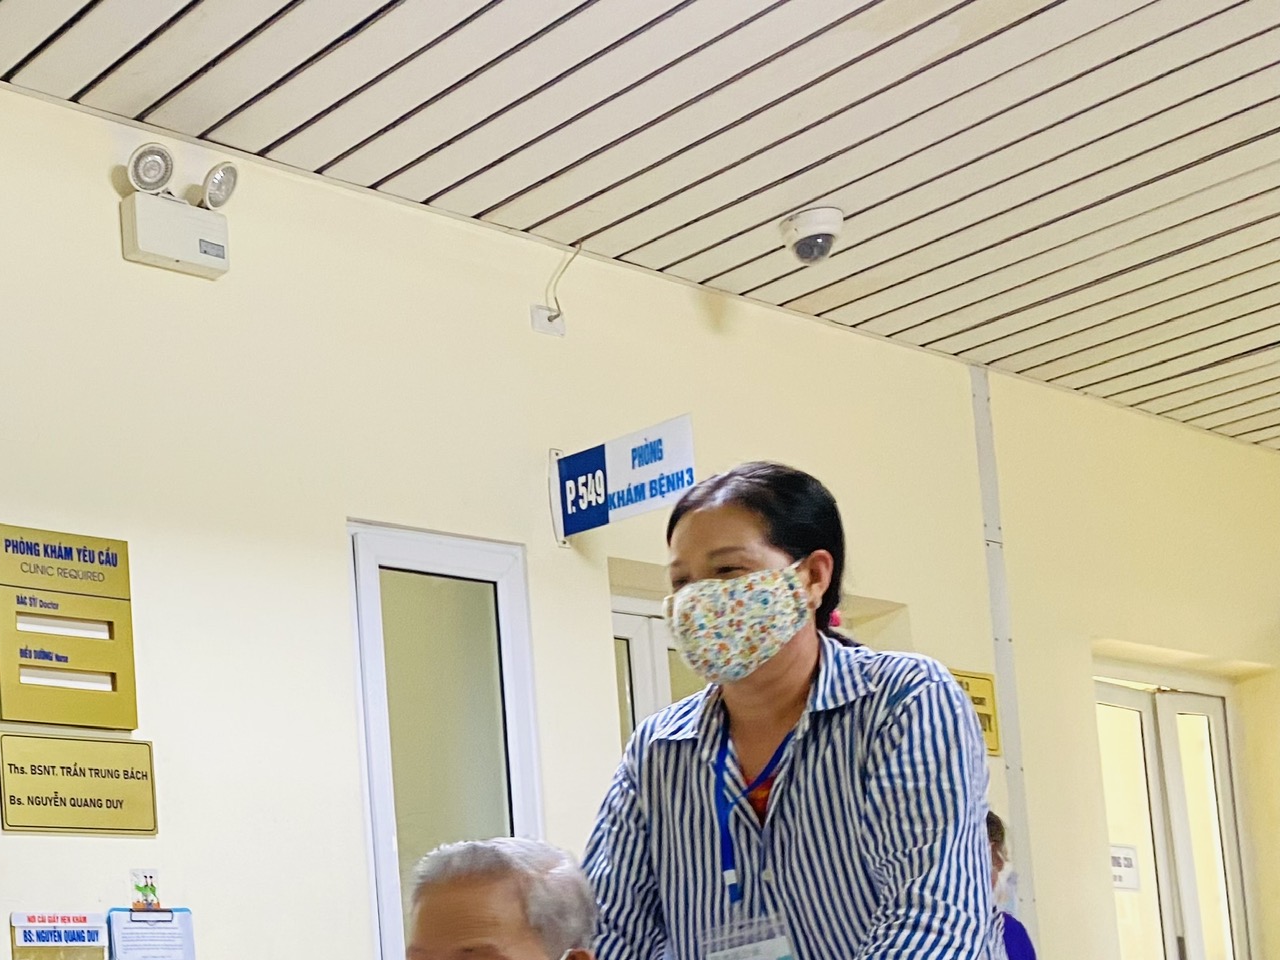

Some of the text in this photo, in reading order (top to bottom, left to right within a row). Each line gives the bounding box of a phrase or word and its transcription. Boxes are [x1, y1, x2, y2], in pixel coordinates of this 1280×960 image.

[631, 437, 664, 470] PHÒNG
[608, 467, 695, 511] KHÁM BỆNH 3
[4, 537, 40, 557] PHÒNG
[43, 542, 73, 561] KHÁM
[76, 545, 95, 564] YÊU
[20, 562, 105, 582] CLINIC REQUIRED
[7, 763, 27, 775] Ths.
[30, 765, 58, 776] BSNT.
[88, 767, 120, 779] TRUNG
[123, 767, 148, 780] BÁCH
[9, 791, 124, 810] Bs. NGUYỄN QUANG DUY
[64, 929, 86, 943] QUANG
